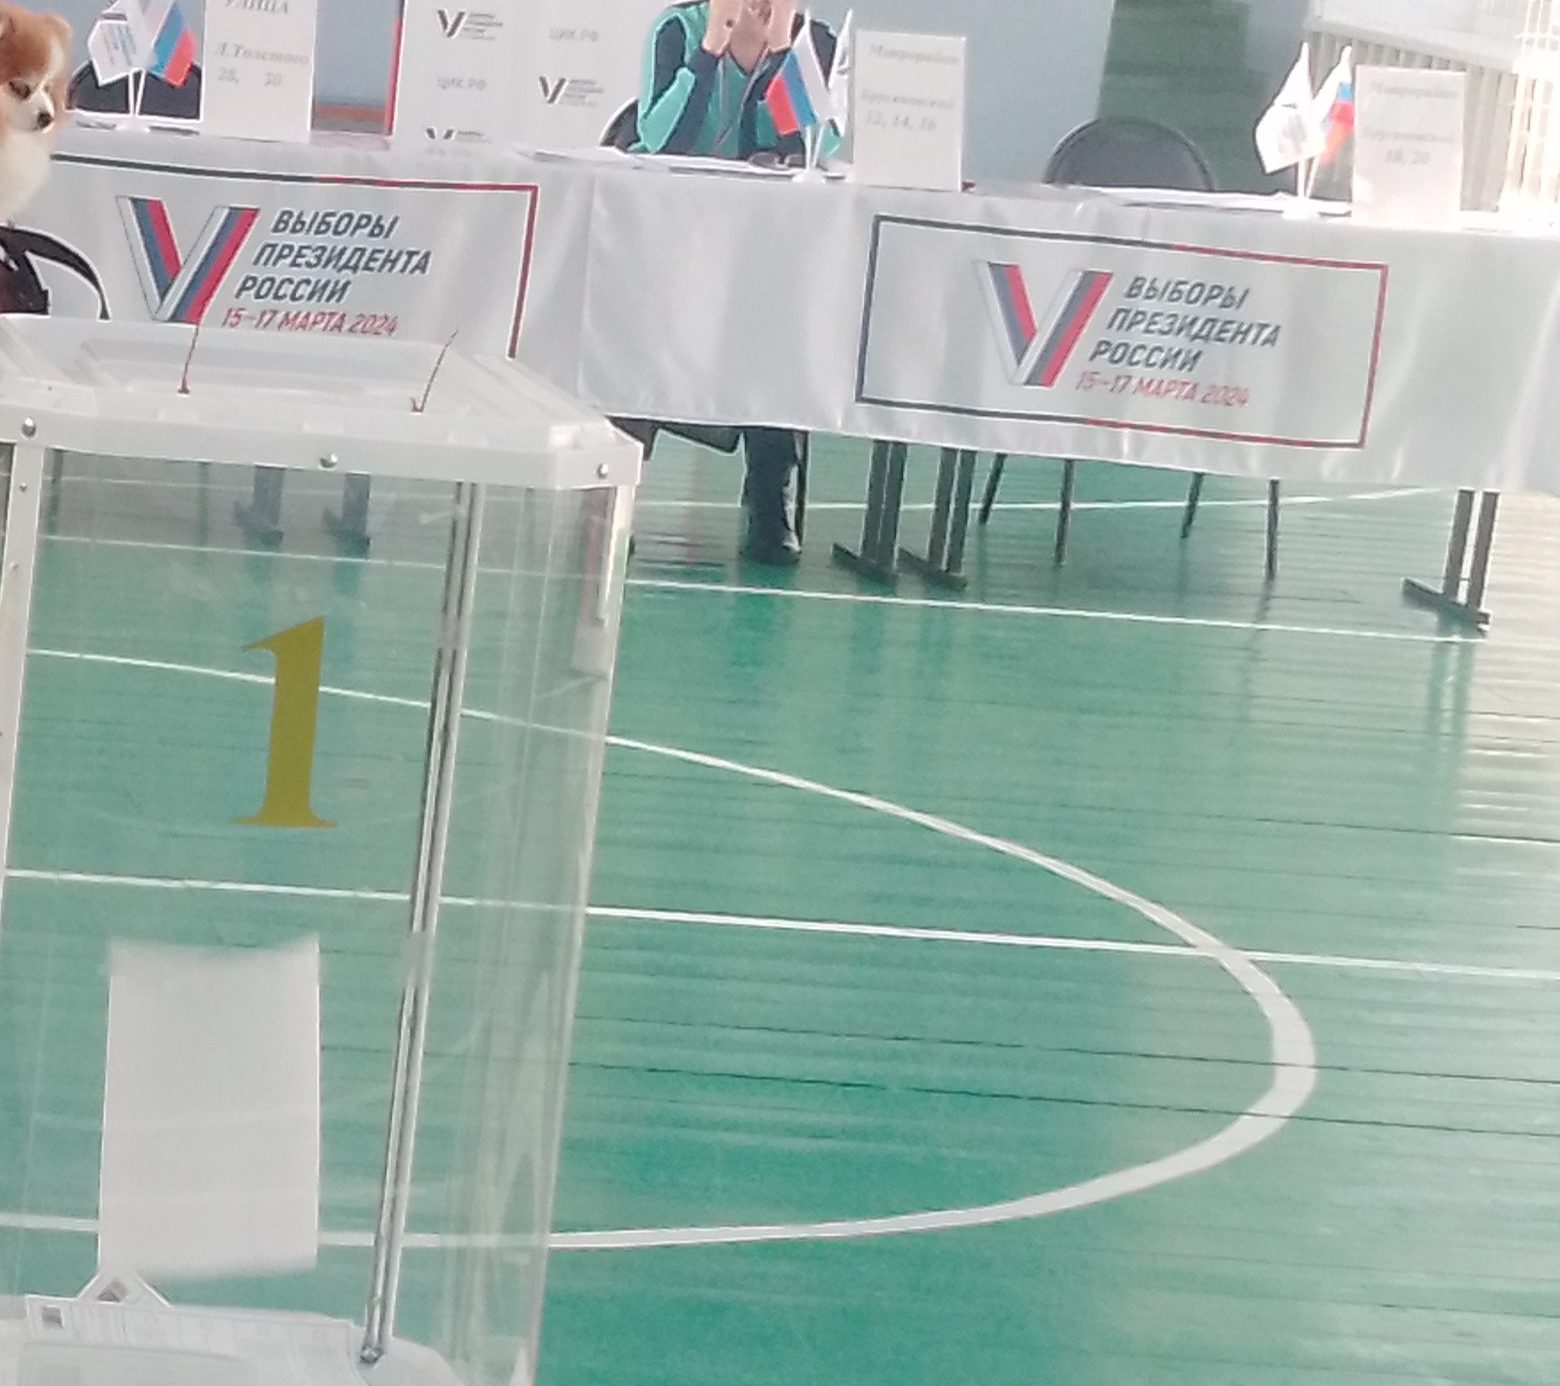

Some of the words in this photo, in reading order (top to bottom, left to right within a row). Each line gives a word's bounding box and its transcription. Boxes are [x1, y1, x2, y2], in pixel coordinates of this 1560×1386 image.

[270, 208, 399, 240] ВЫБОРЫ
[252, 241, 432, 275] ПРЕЗИДЕНТА
[234, 274, 351, 304] РОССИИ
[1123, 274, 1249, 311] ВЫБОРЫ
[277, 310, 347, 333] МАРТА
[347, 313, 398, 336] 2024
[1107, 307, 1281, 347] ПРЕЗИДЕНТА
[1089, 339, 1202, 373] РОССИИ
[1132, 375, 1199, 400] МАРТА
[1200, 384, 1249, 406] 2024
[236, 616, 337, 827] 1
